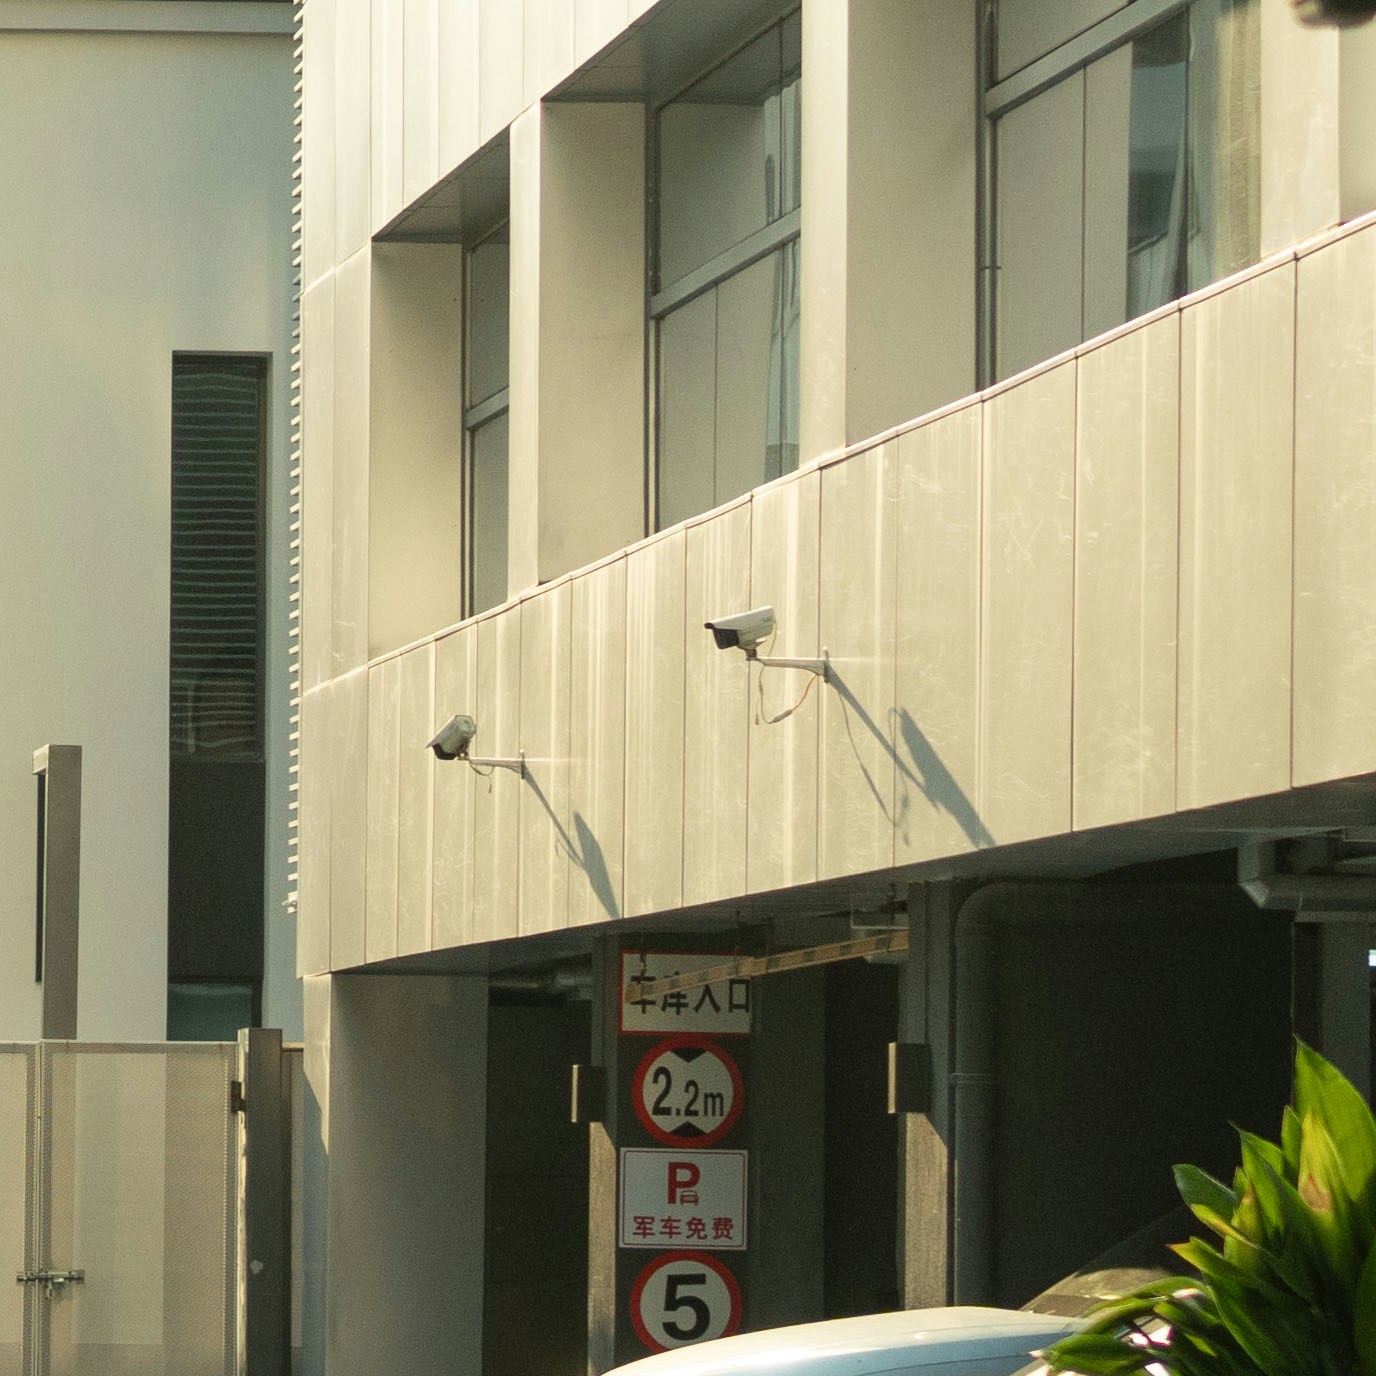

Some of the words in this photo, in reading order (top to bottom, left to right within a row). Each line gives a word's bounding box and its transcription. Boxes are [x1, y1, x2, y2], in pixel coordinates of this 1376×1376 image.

[652, 1065, 725, 1118] 2.2m
[666, 1161, 701, 1205] P
[632, 1215, 735, 1240] 军车免费
[662, 1273, 712, 1342] 5
